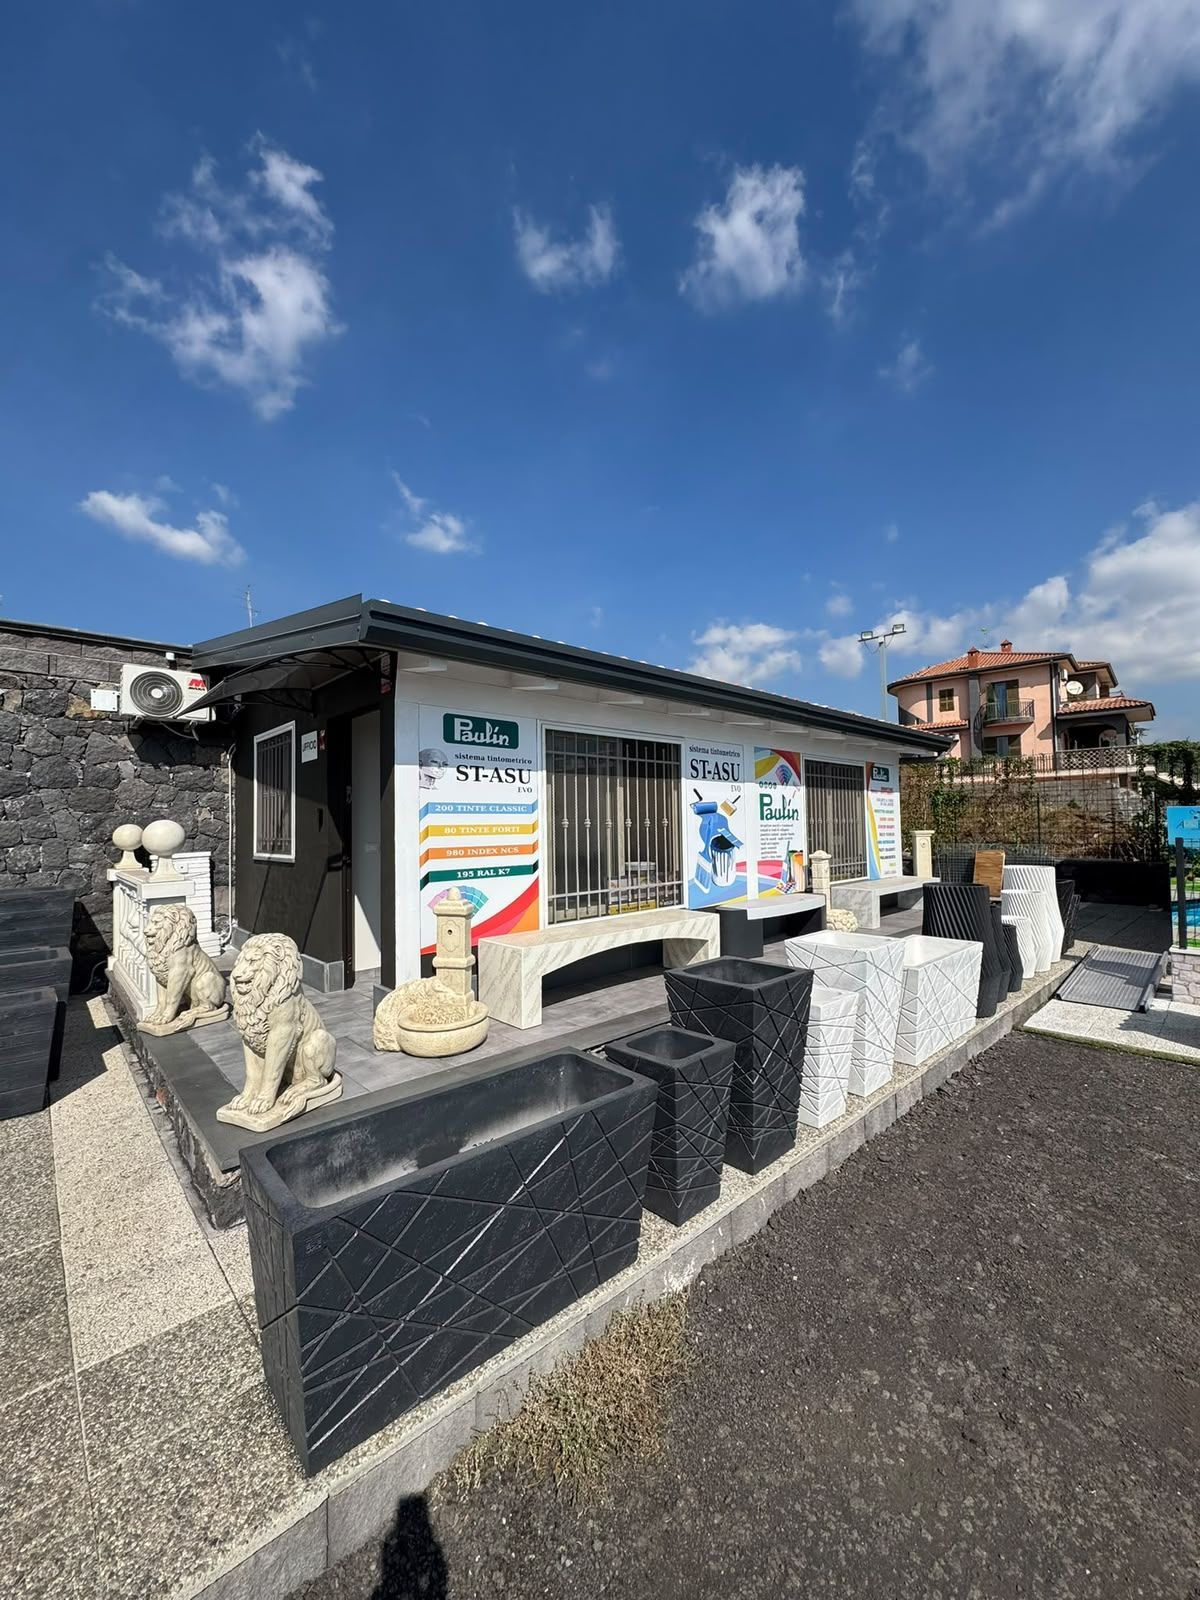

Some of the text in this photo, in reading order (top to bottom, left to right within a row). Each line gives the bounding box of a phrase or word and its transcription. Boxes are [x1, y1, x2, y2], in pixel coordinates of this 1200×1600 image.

[689, 744, 741, 758] sistema tintometrico
[454, 753, 533, 764] sistema tintometrico
[456, 764, 532, 784] ST-ASU
[690, 758, 741, 782] ST-ASU
[435, 804, 454, 812] 200
[446, 849, 465, 857] 980
[477, 869, 497, 877] RAL
